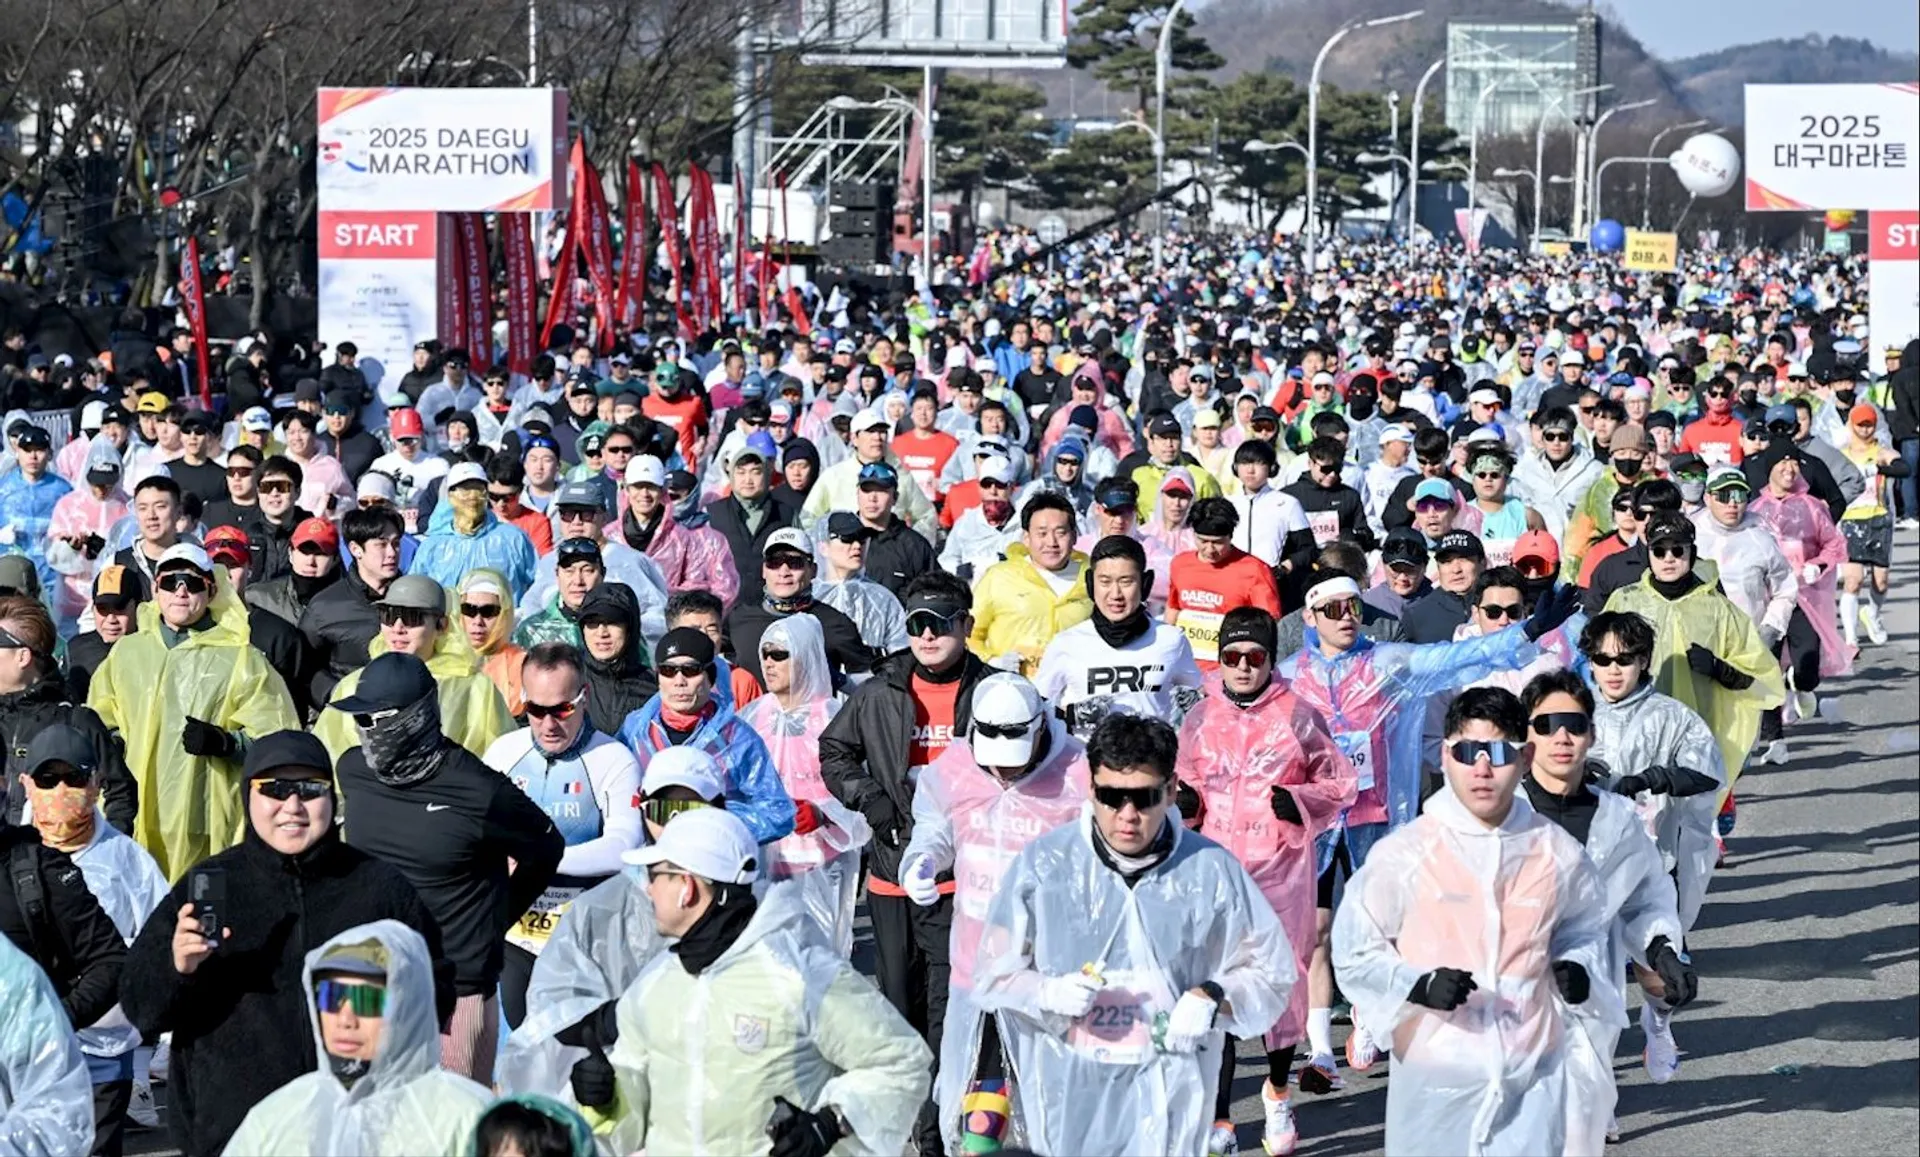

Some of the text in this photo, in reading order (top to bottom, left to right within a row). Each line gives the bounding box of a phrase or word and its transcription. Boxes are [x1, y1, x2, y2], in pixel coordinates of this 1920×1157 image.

[1800, 115, 1881, 138] 2025
[369, 128, 530, 149] 2025 DAEGU
[368, 153, 530, 175] MARATHON
[1774, 143, 1908, 168] 대구마라톤
[334, 223, 420, 247] START
[1657, 251, 1669, 265] A
[1181, 589, 1224, 606] DAEGU
